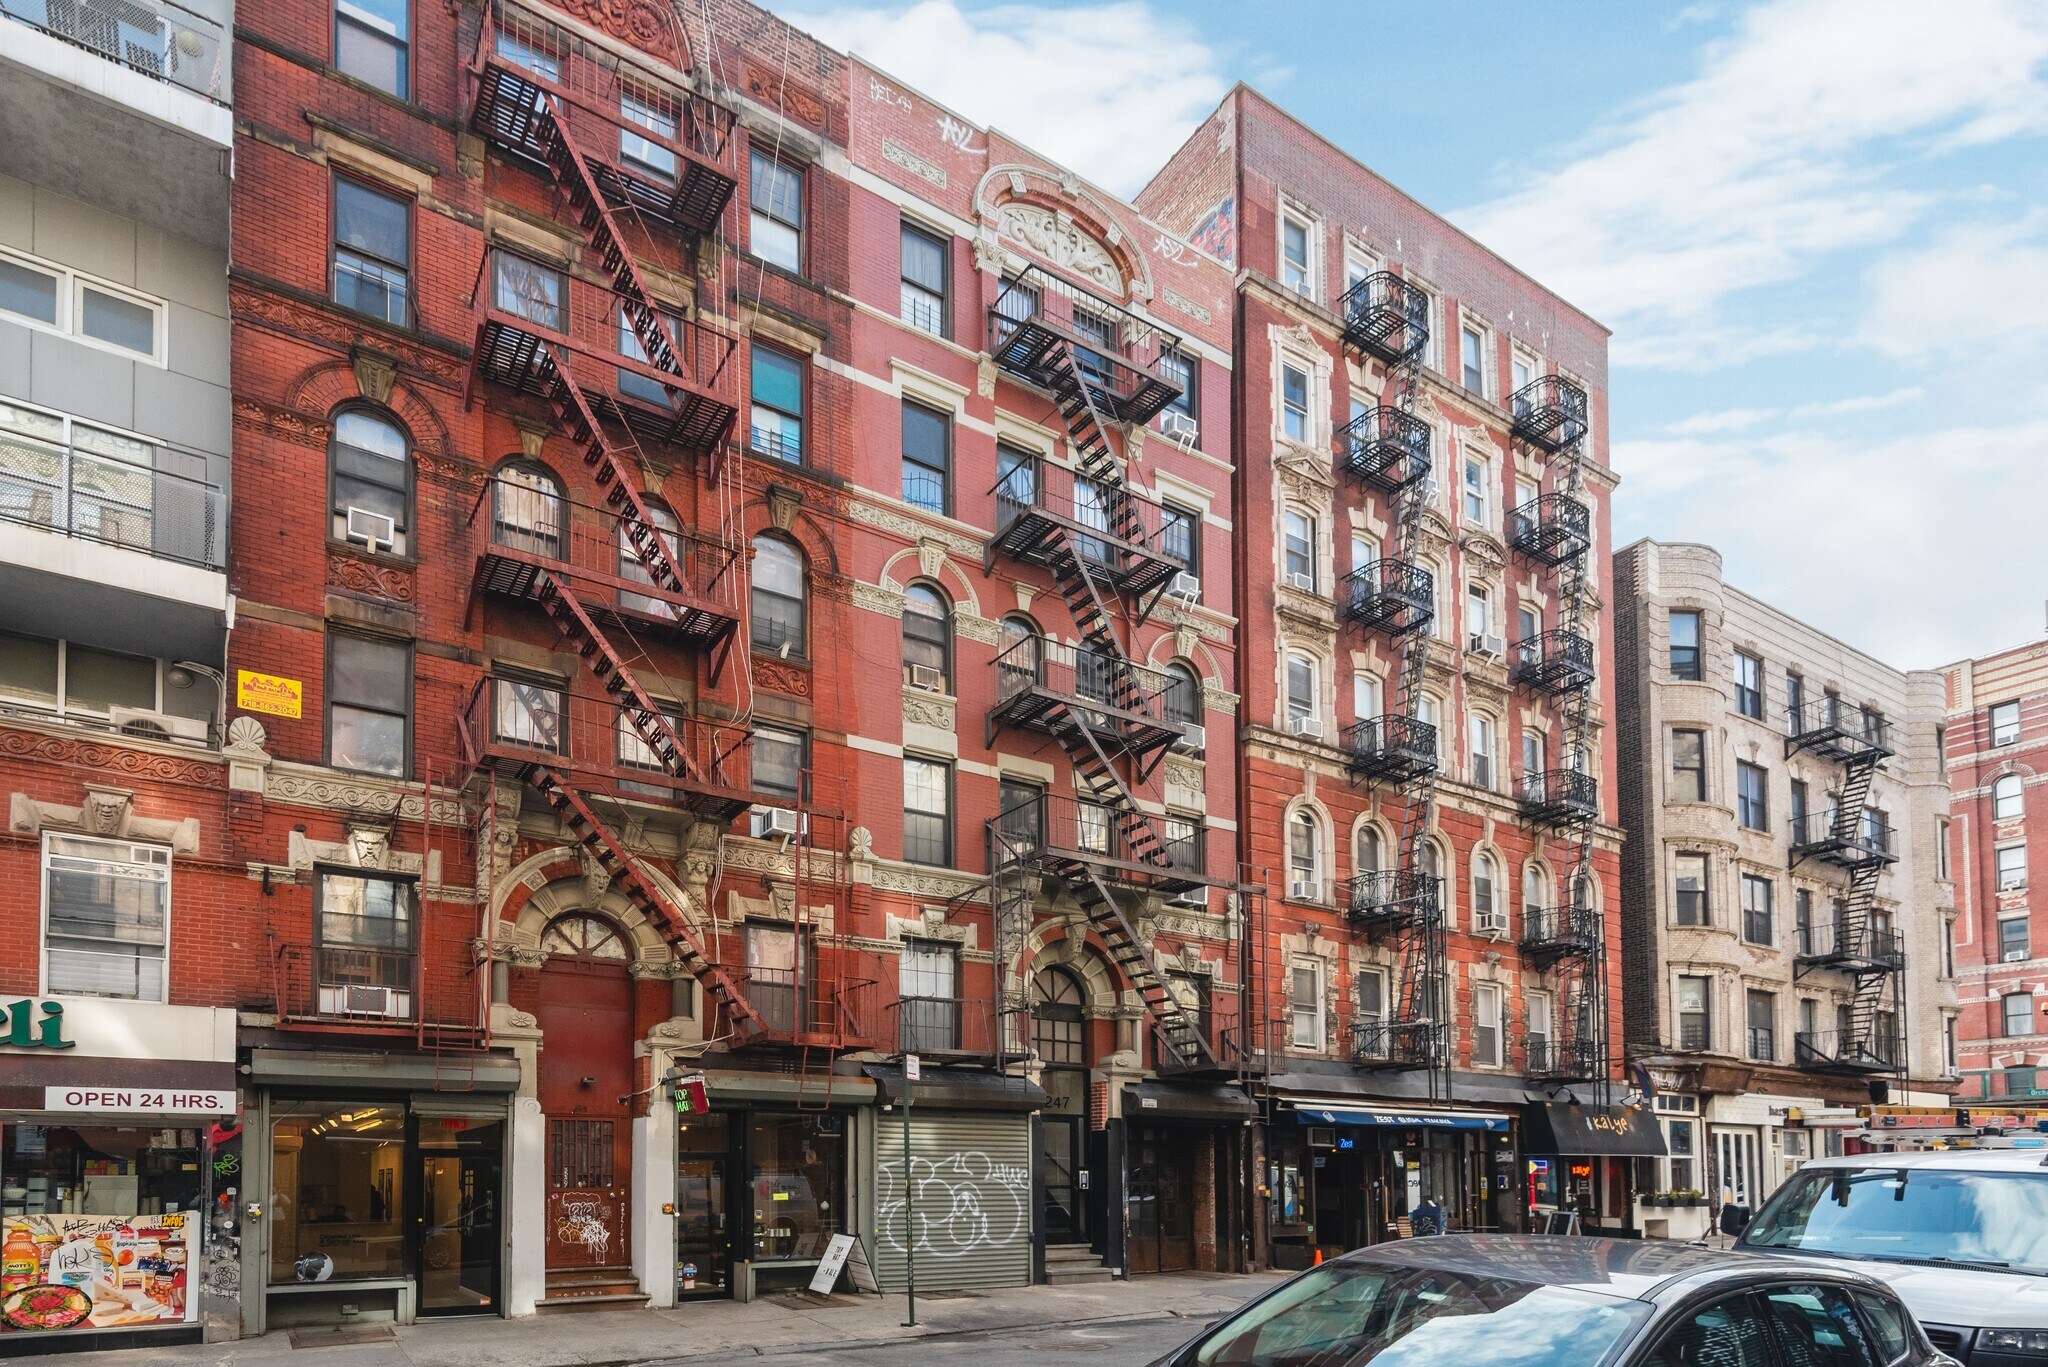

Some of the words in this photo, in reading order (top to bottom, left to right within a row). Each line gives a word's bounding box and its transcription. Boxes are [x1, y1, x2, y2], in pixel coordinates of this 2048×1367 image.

[65, 1091, 131, 1106] OPEN
[140, 1093, 165, 1107] 24
[172, 1094, 224, 1109] HRS.
[674, 1089, 688, 1101] TOP
[676, 1100, 690, 1113] HAT
[1045, 1096, 1070, 1109] 247
[1374, 1115, 1395, 1123] ZEST
